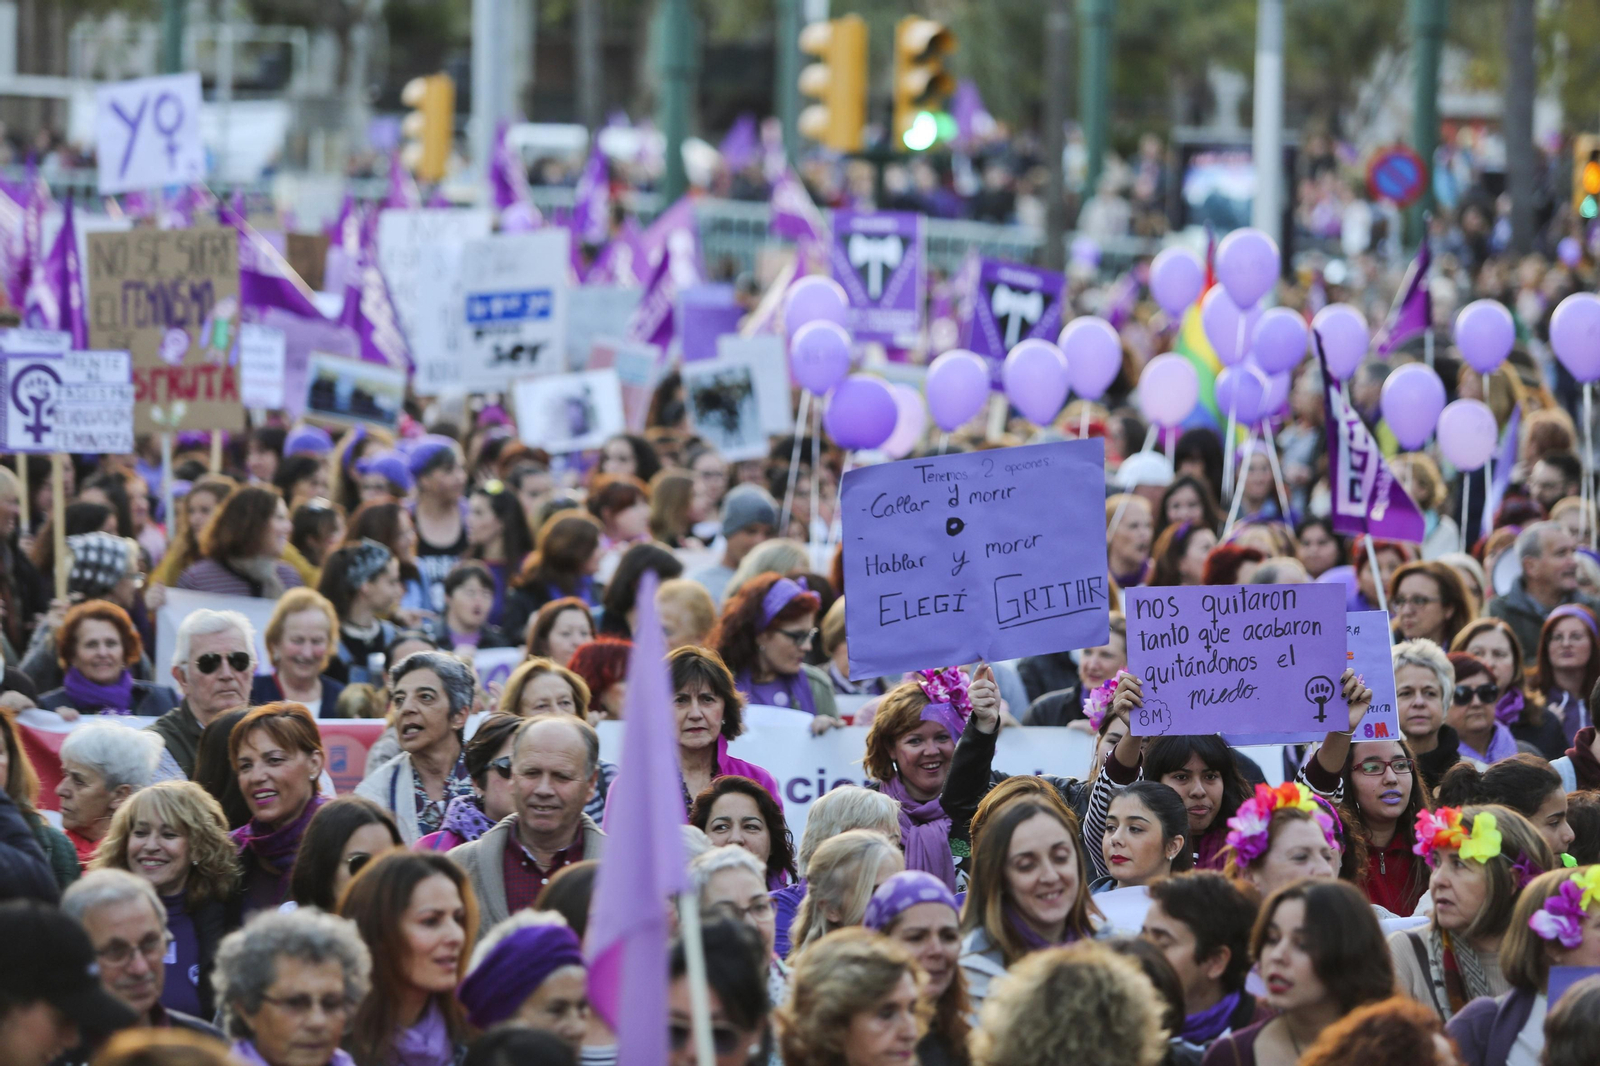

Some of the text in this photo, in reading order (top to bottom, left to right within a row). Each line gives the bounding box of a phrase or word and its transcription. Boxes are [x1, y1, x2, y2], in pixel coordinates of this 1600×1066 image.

[913, 464, 969, 484] Tenemos
[981, 458, 994, 478] 2
[947, 483, 960, 508] y
[968, 486, 1017, 505] morir
[865, 552, 927, 577] Hablar
[951, 550, 970, 577] y
[985, 534, 1043, 559] morir
[879, 573, 1107, 627] ELEGÍ GRITAR
[1136, 586, 1297, 632] nos quitaron
[1137, 617, 1322, 654] tanto que acabaron
[1144, 643, 1296, 695] quitándonos el
[1139, 708, 1163, 727] 8M
